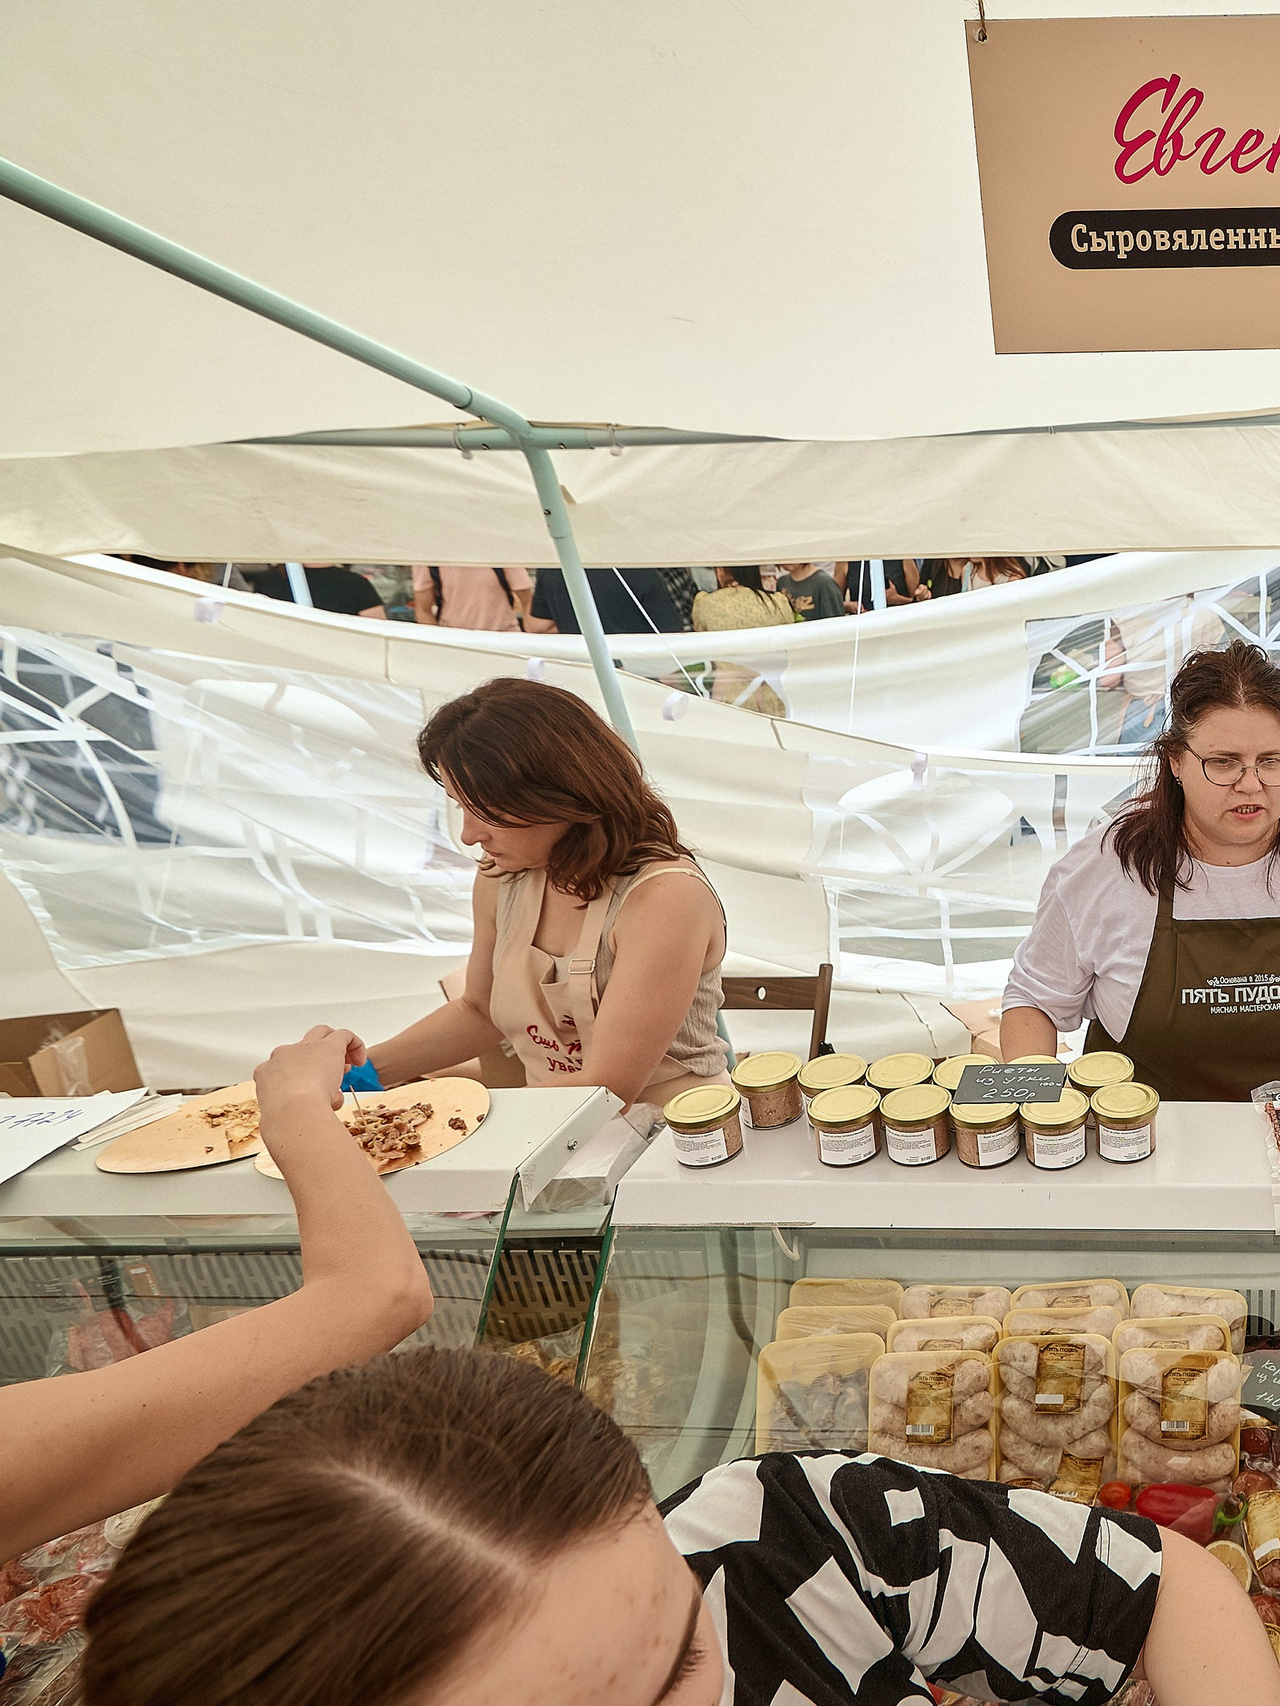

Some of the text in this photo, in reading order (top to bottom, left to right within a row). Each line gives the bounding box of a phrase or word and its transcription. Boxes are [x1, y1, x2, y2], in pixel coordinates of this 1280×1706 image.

[1254, 974, 1270, 983] 2015
[1181, 988, 1230, 1004] ПЯТЬ
[1210, 1005, 1238, 1014] МЯСНАЯ
[976, 1078, 995, 1086] из
[1002, 1076, 1050, 1084] утки
